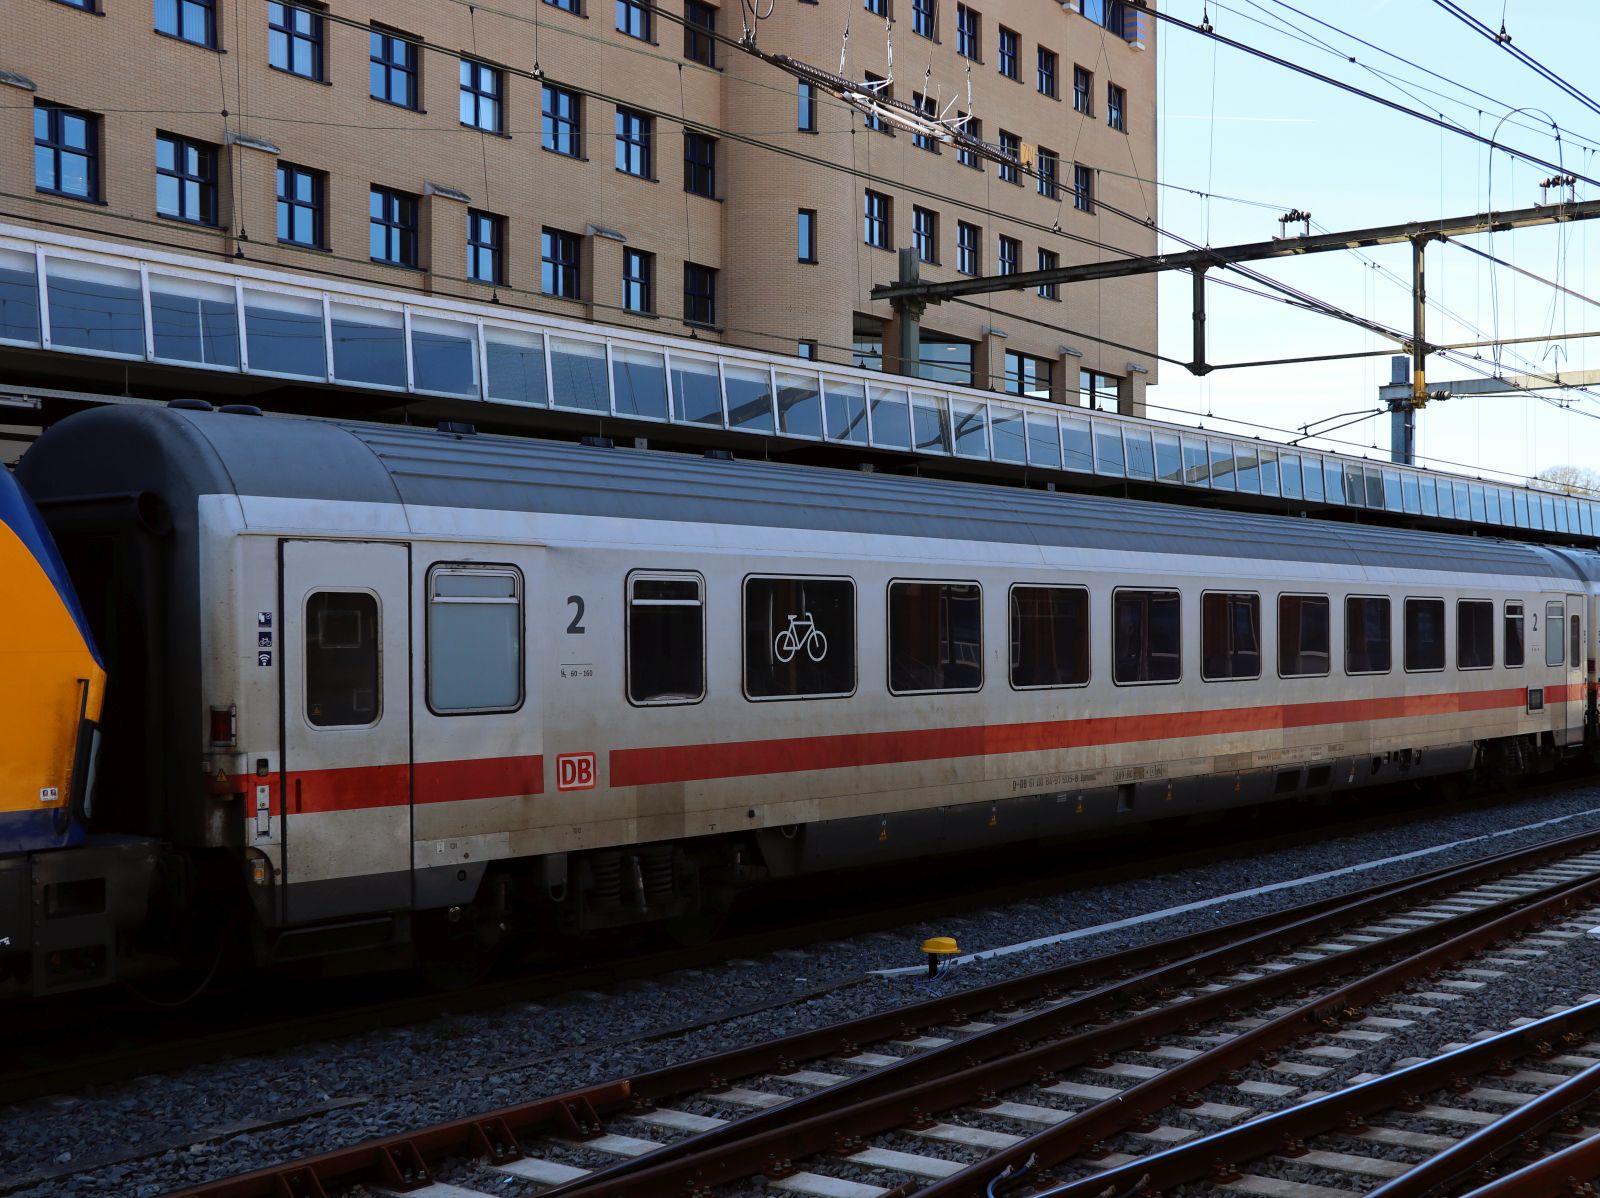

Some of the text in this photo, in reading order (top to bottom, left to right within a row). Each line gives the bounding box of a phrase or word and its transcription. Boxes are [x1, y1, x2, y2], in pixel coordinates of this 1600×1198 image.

[566, 595, 585, 634] 2
[1532, 613, 1538, 631] 2
[561, 758, 592, 785] DB
